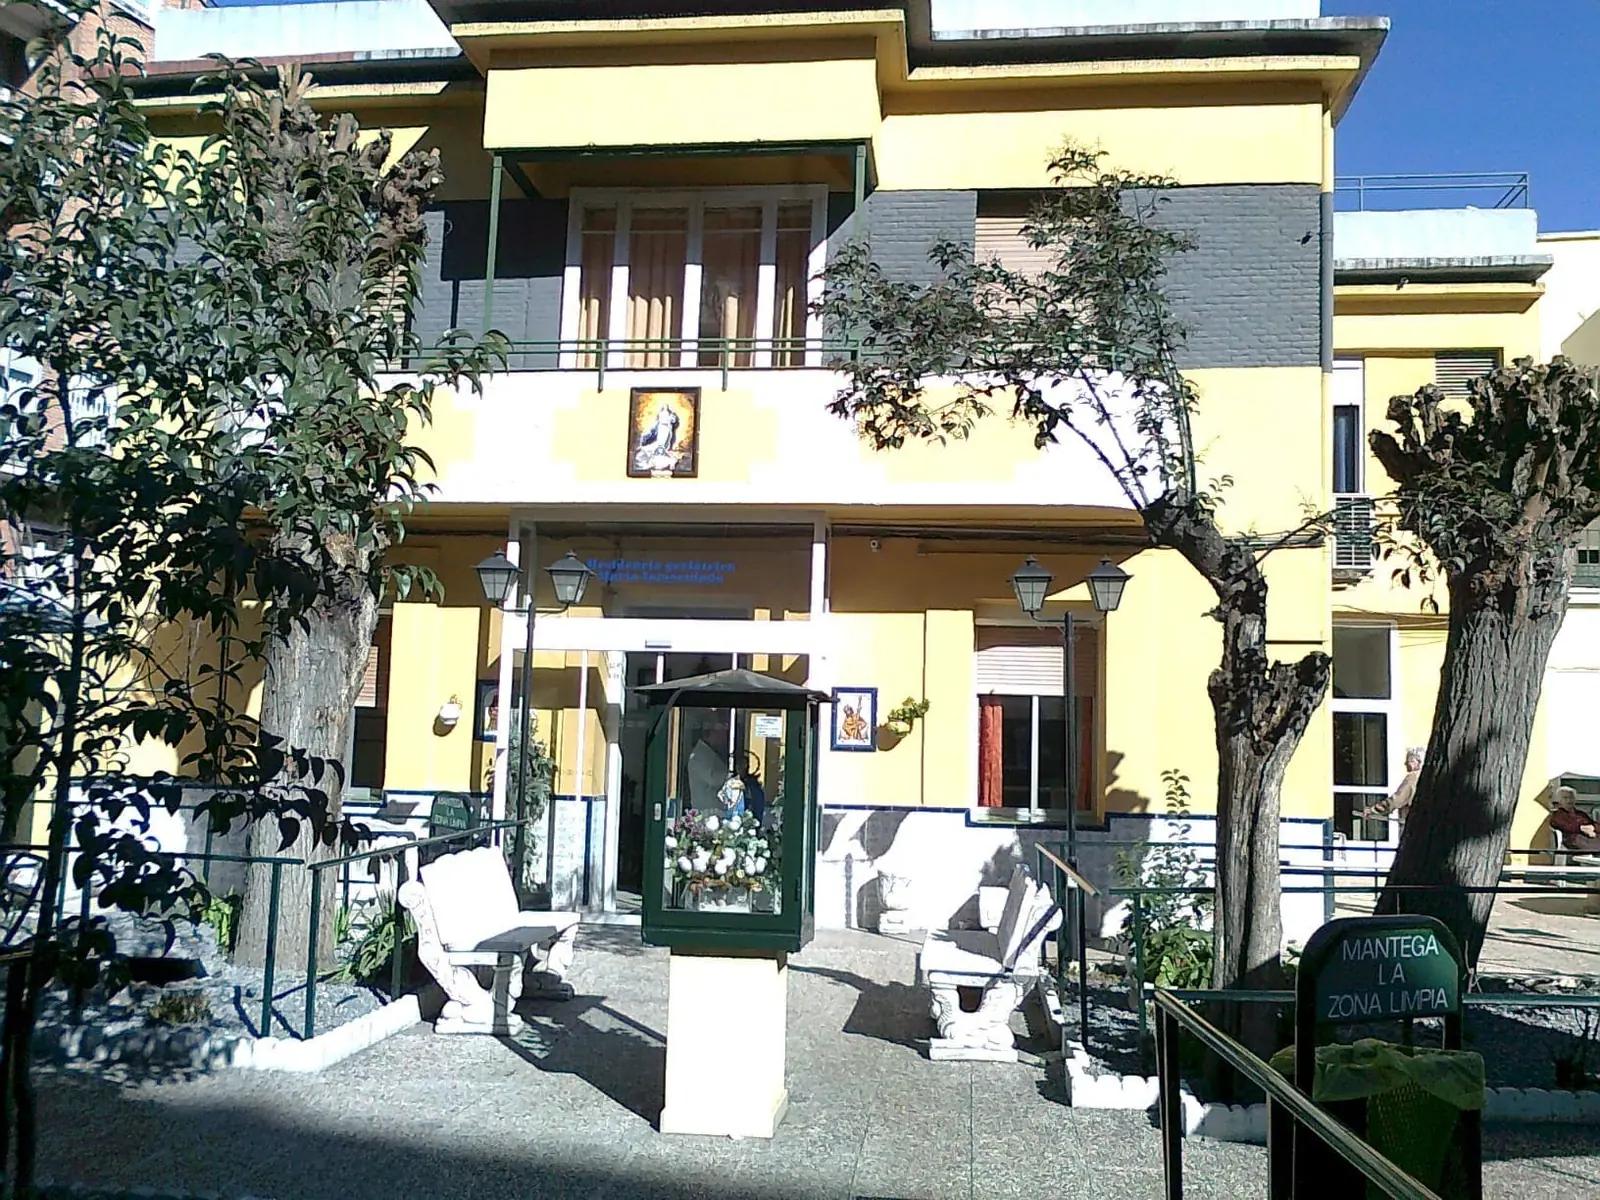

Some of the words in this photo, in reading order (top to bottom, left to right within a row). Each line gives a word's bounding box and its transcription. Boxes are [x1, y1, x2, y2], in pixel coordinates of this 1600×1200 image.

[1342, 934, 1440, 961] MANTEGA
[1377, 962, 1407, 985] LA
[1327, 992, 1383, 1019] ZONA
[1389, 987, 1449, 1014] LIMPIA
